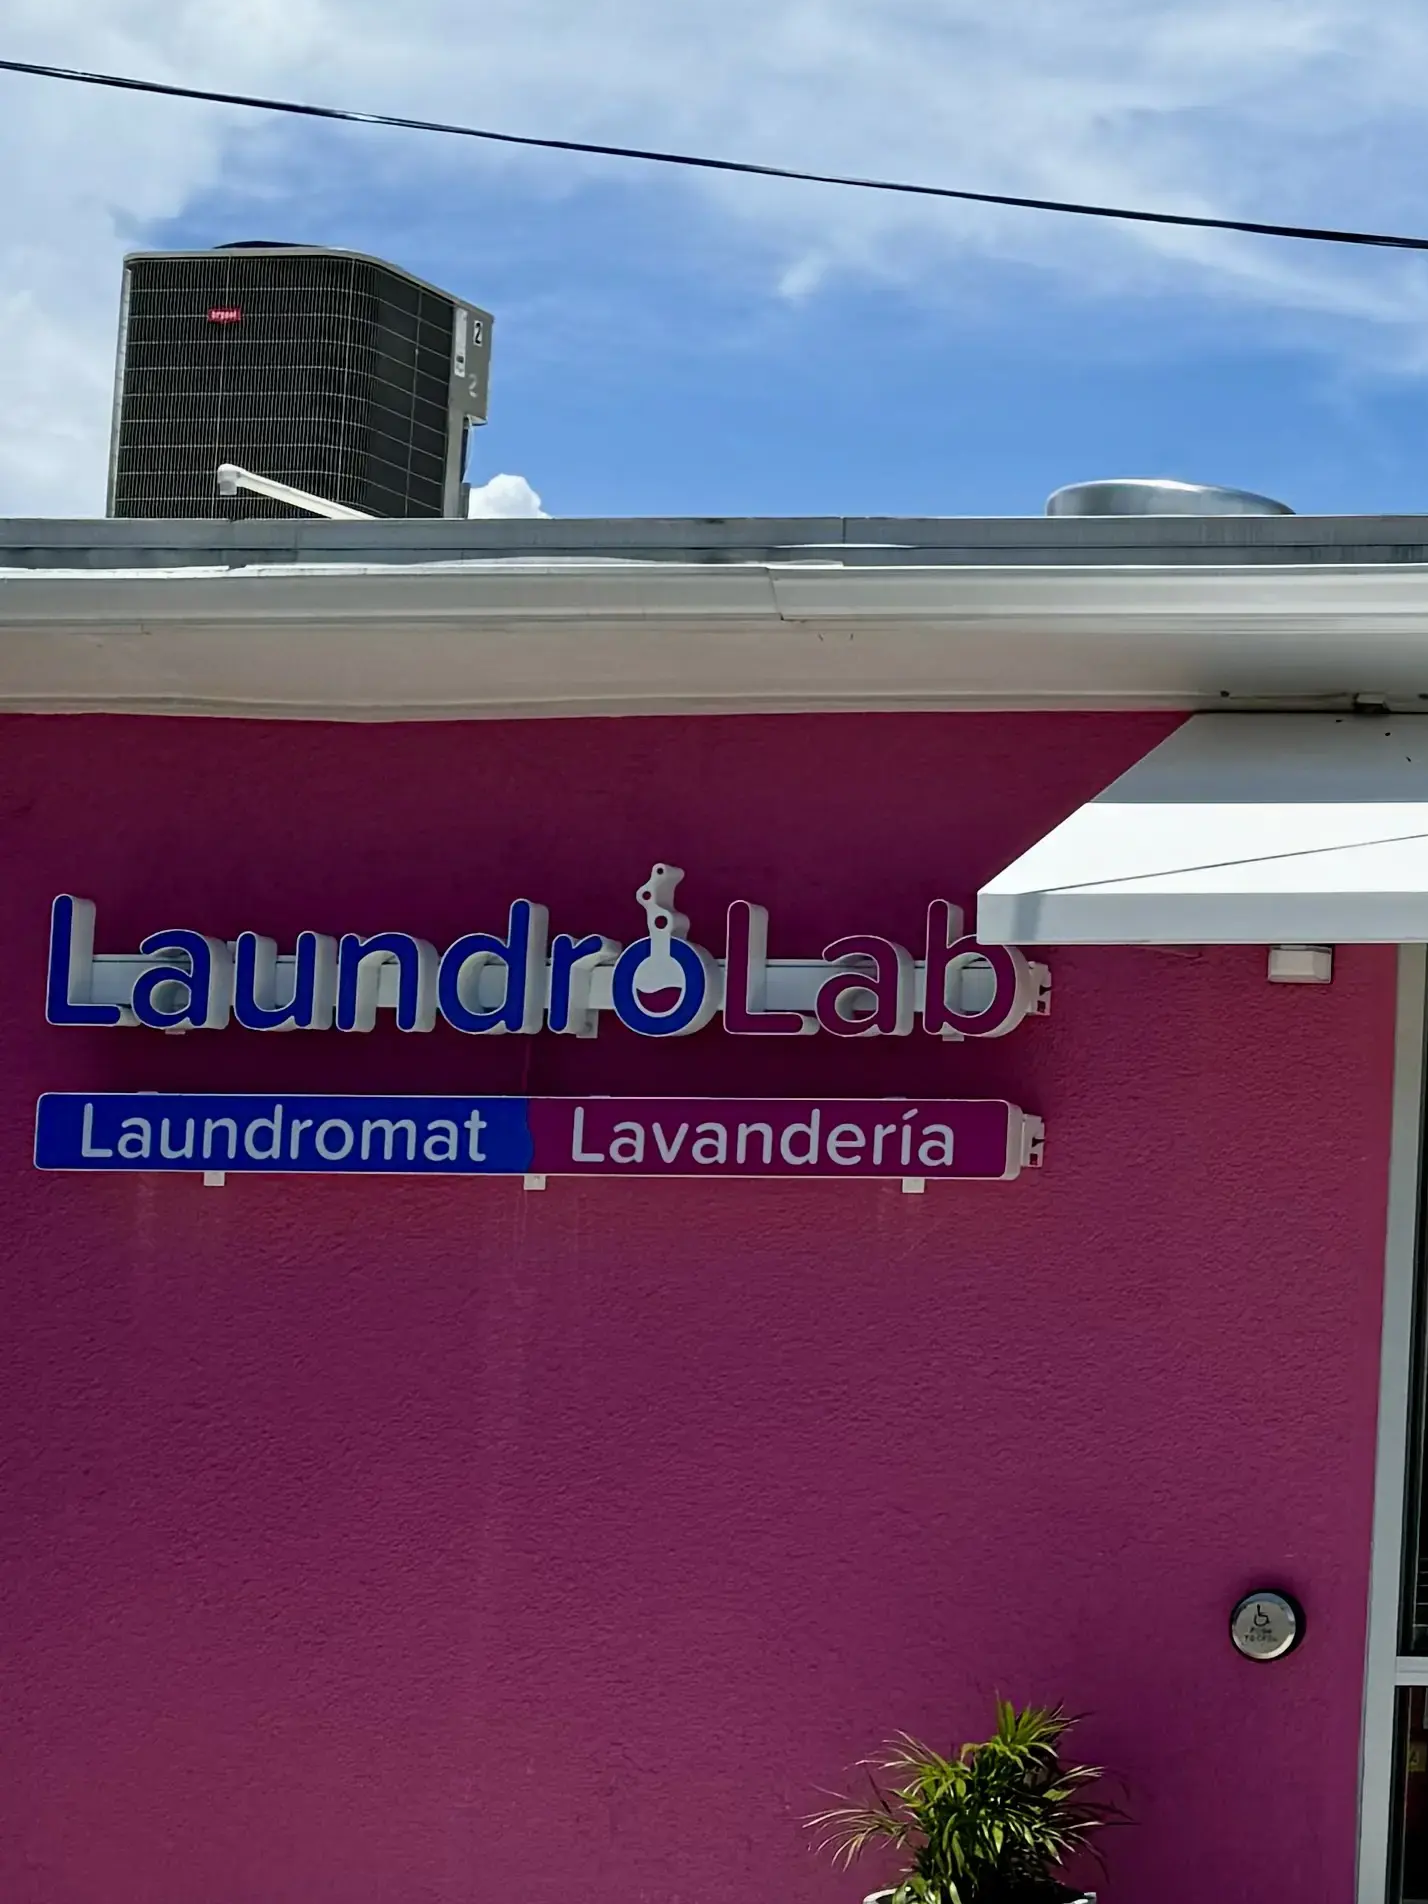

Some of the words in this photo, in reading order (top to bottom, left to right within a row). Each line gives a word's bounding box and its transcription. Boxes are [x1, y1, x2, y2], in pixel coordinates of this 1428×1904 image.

[46, 863, 1030, 1037] LaundroLab
[79, 1102, 488, 1164] Laundromat
[571, 1107, 956, 1168] Lavandería
